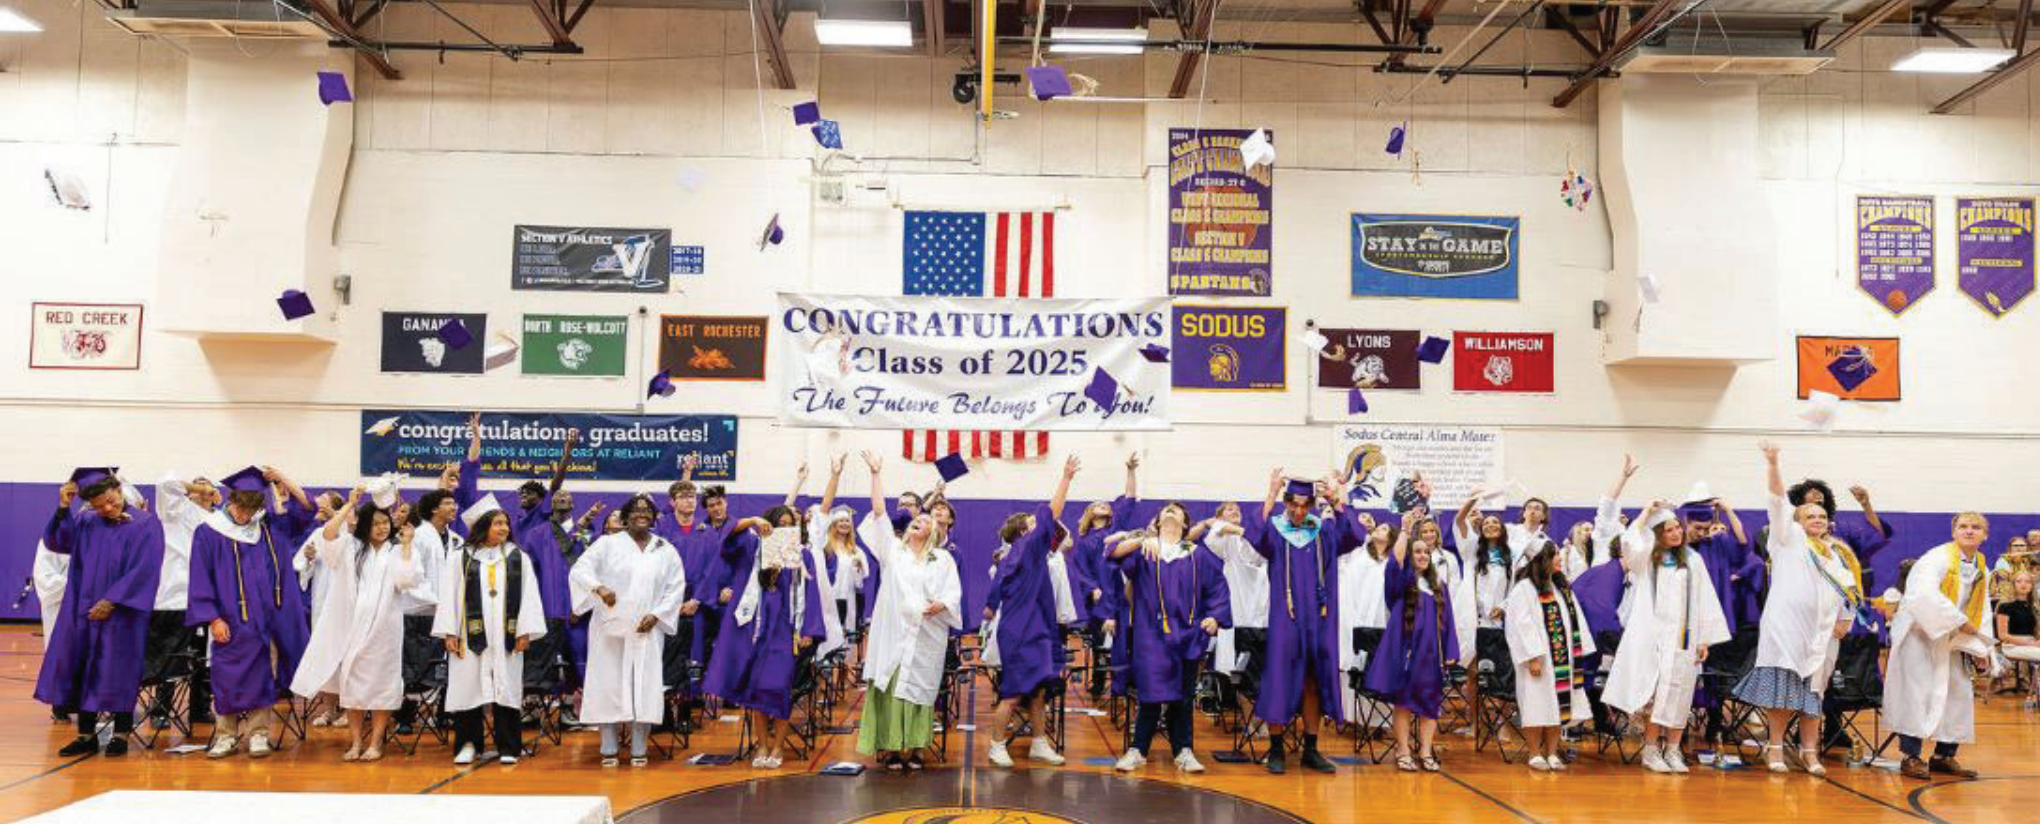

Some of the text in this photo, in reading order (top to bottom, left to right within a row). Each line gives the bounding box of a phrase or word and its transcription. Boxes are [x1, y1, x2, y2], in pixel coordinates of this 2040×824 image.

[1171, 208, 1201, 223] CLASS
[1212, 208, 1269, 224] CHAMPIONS
[1861, 206, 1931, 230] CHAMPIONS
[1960, 208, 2031, 232] CHAMPIONS
[522, 234, 613, 245] SECTION V ATHLETICS
[1195, 230, 1237, 246] SECTION
[1367, 237, 1418, 252] STAY
[1442, 239, 1503, 254] GAME
[1171, 247, 1201, 262] CLASS
[1212, 249, 1269, 263] CHAMPIONS
[1375, 252, 1449, 260] SPORTSMANSHIP
[1171, 275, 1250, 290] SPARTANS
[46, 310, 128, 325] RED CREEK
[403, 317, 466, 330] GANAN
[783, 307, 1164, 338] CONGRATULATIONS
[1181, 313, 1266, 337] SODUS
[524, 320, 626, 335] NORTH ROSE-WOLCOTT
[667, 324, 761, 338] EAST ROCHESTER
[1347, 334, 1392, 349] LYONS
[1464, 336, 1544, 351] WILLIAMSON
[851, 345, 1088, 376] Class of 2025
[793, 386, 846, 414] The
[853, 385, 940, 416] Future
[947, 392, 1037, 420] Belongs
[1047, 392, 1087, 418] To
[399, 419, 709, 448] congratulation, graduates!
[1344, 427, 1497, 443] Sodus Central Alma Mater
[399, 446, 661, 459] FROM YOUR IENDS & NEIGHORS AT RELIANT
[677, 450, 729, 465] rliant
[510, 460, 531, 471] that
